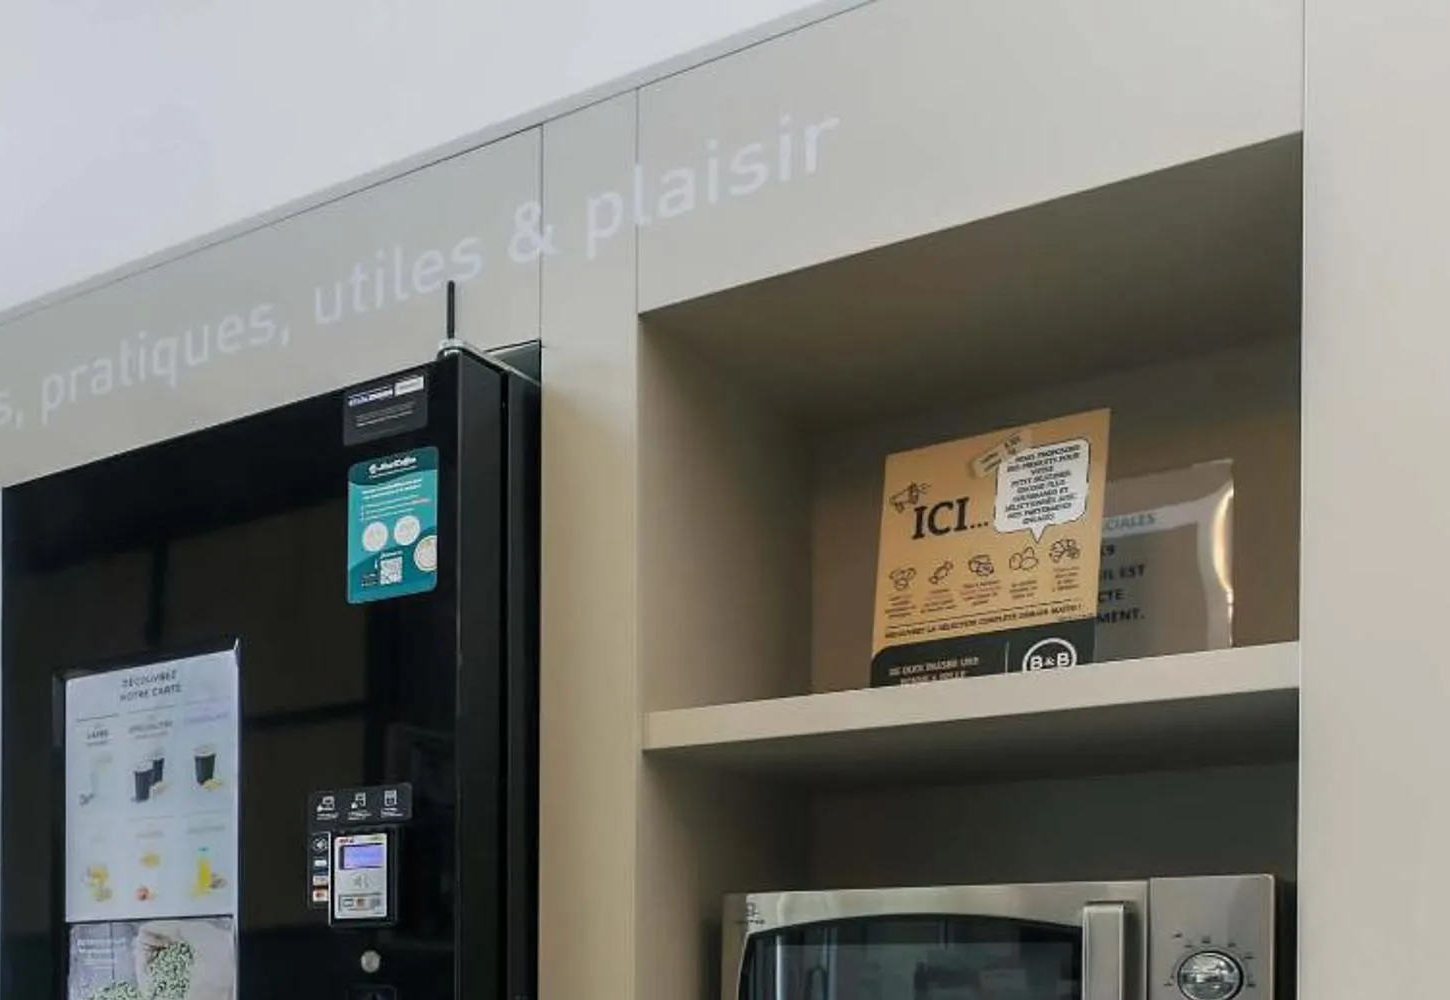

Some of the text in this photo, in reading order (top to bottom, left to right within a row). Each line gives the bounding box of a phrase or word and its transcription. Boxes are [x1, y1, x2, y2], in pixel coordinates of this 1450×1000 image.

[41, 304, 291, 426] pratiques,
[312, 237, 482, 325] utiles
[507, 201, 558, 264] &
[586, 114, 840, 261] plaisir
[1106, 513, 1156, 532] CIALES
[1097, 607, 1145, 625] MENT.
